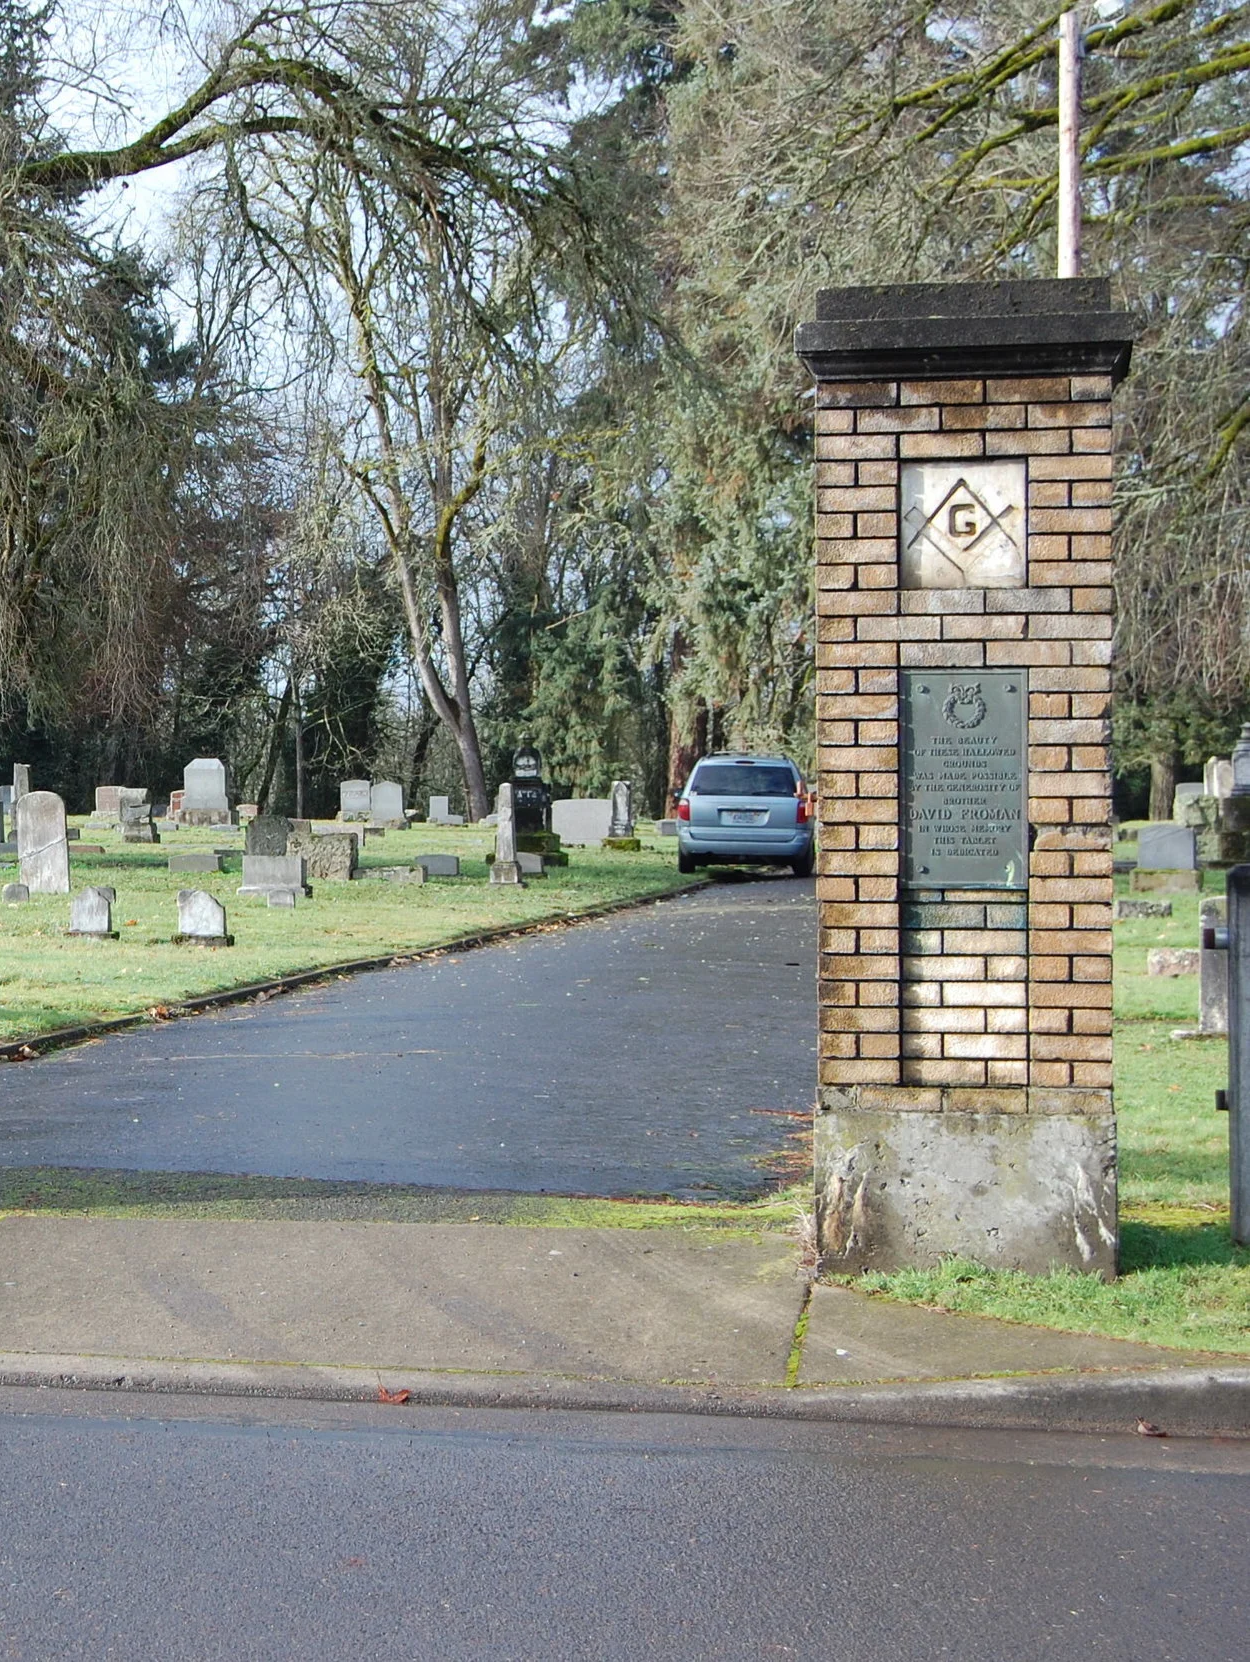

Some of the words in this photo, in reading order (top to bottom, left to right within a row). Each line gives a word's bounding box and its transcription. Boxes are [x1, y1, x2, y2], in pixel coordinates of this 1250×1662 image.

[948, 503, 977, 538] G
[932, 736, 952, 745] THE
[958, 736, 998, 745] BEAUTY
[914, 749, 926, 757] OF
[930, 749, 959, 757] THESE
[962, 749, 1016, 757] HALLOWED
[943, 760, 988, 769] GROUNDS
[914, 772, 934, 780] WAS
[939, 772, 967, 780] MADE
[971, 772, 1017, 780] POSSIBLE
[925, 784, 944, 792] THE
[946, 784, 1006, 792] GENEROSITY
[1008, 784, 1022, 792] OF
[943, 797, 987, 806] BROTHER
[909, 808, 953, 820] DAVID
[961, 808, 1021, 820] FROMAN
[919, 825, 929, 833] IN
[934, 825, 966, 833] WHOSE
[971, 825, 1012, 833] MEMORY
[934, 837, 955, 845] THIS
[960, 837, 997, 845] TABLET
[932, 848, 941, 857] IS
[947, 848, 999, 857] DEDICATED
